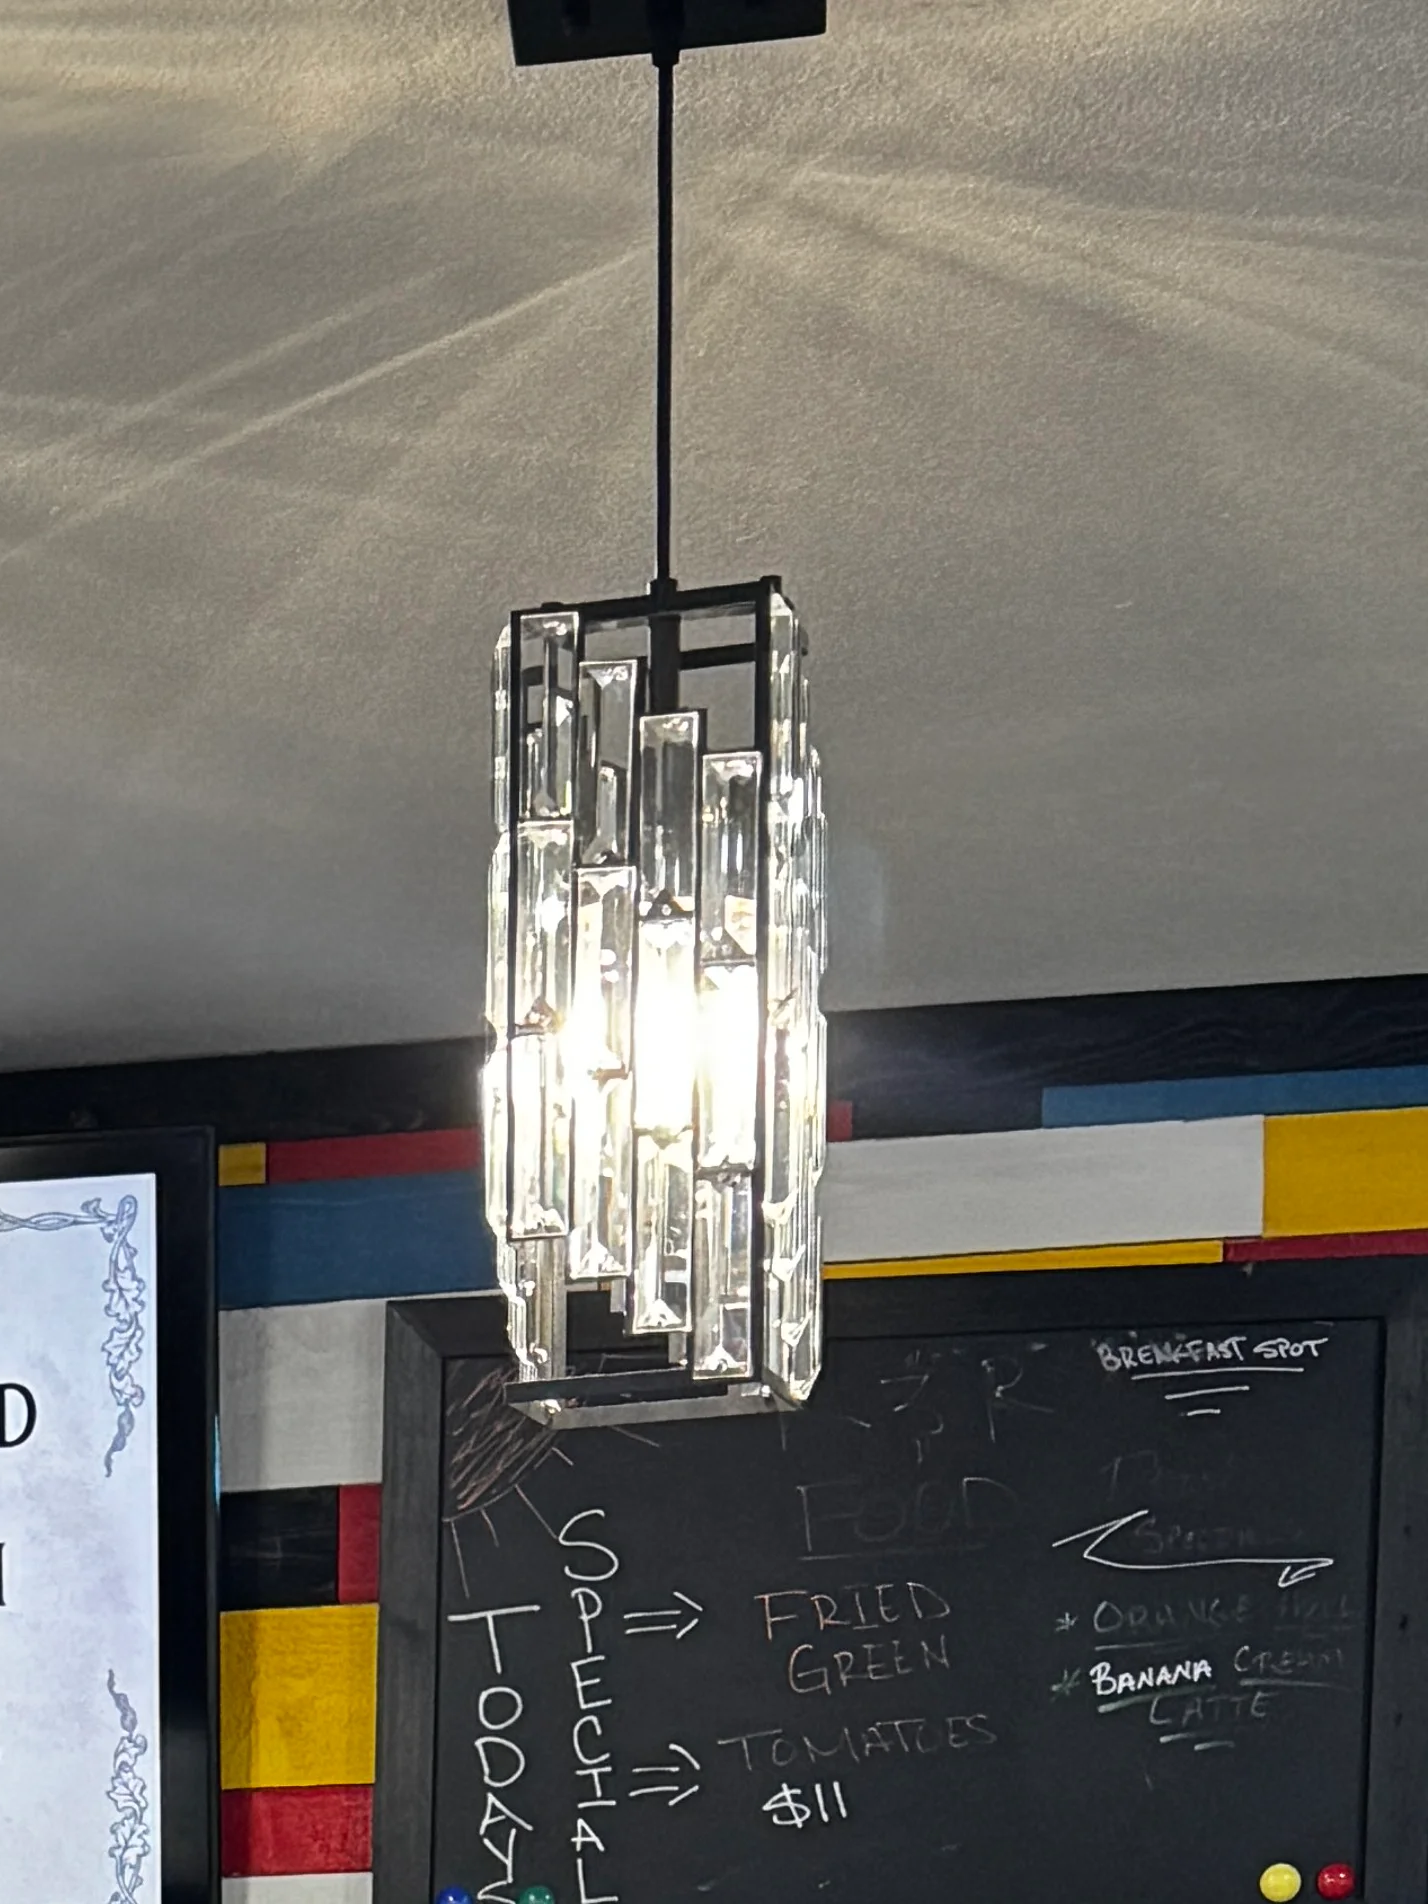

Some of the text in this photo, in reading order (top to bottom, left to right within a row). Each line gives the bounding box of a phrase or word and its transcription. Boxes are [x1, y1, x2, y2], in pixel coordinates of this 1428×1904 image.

[1252, 1337, 1329, 1359] SPOT
[754, 1582, 950, 1640] FRIED
[788, 1634, 950, 1695] GREEN
[1090, 1659, 1212, 1696] BANANA
[717, 1713, 997, 1772] TOMATOES
[761, 1781, 848, 1828] $11
